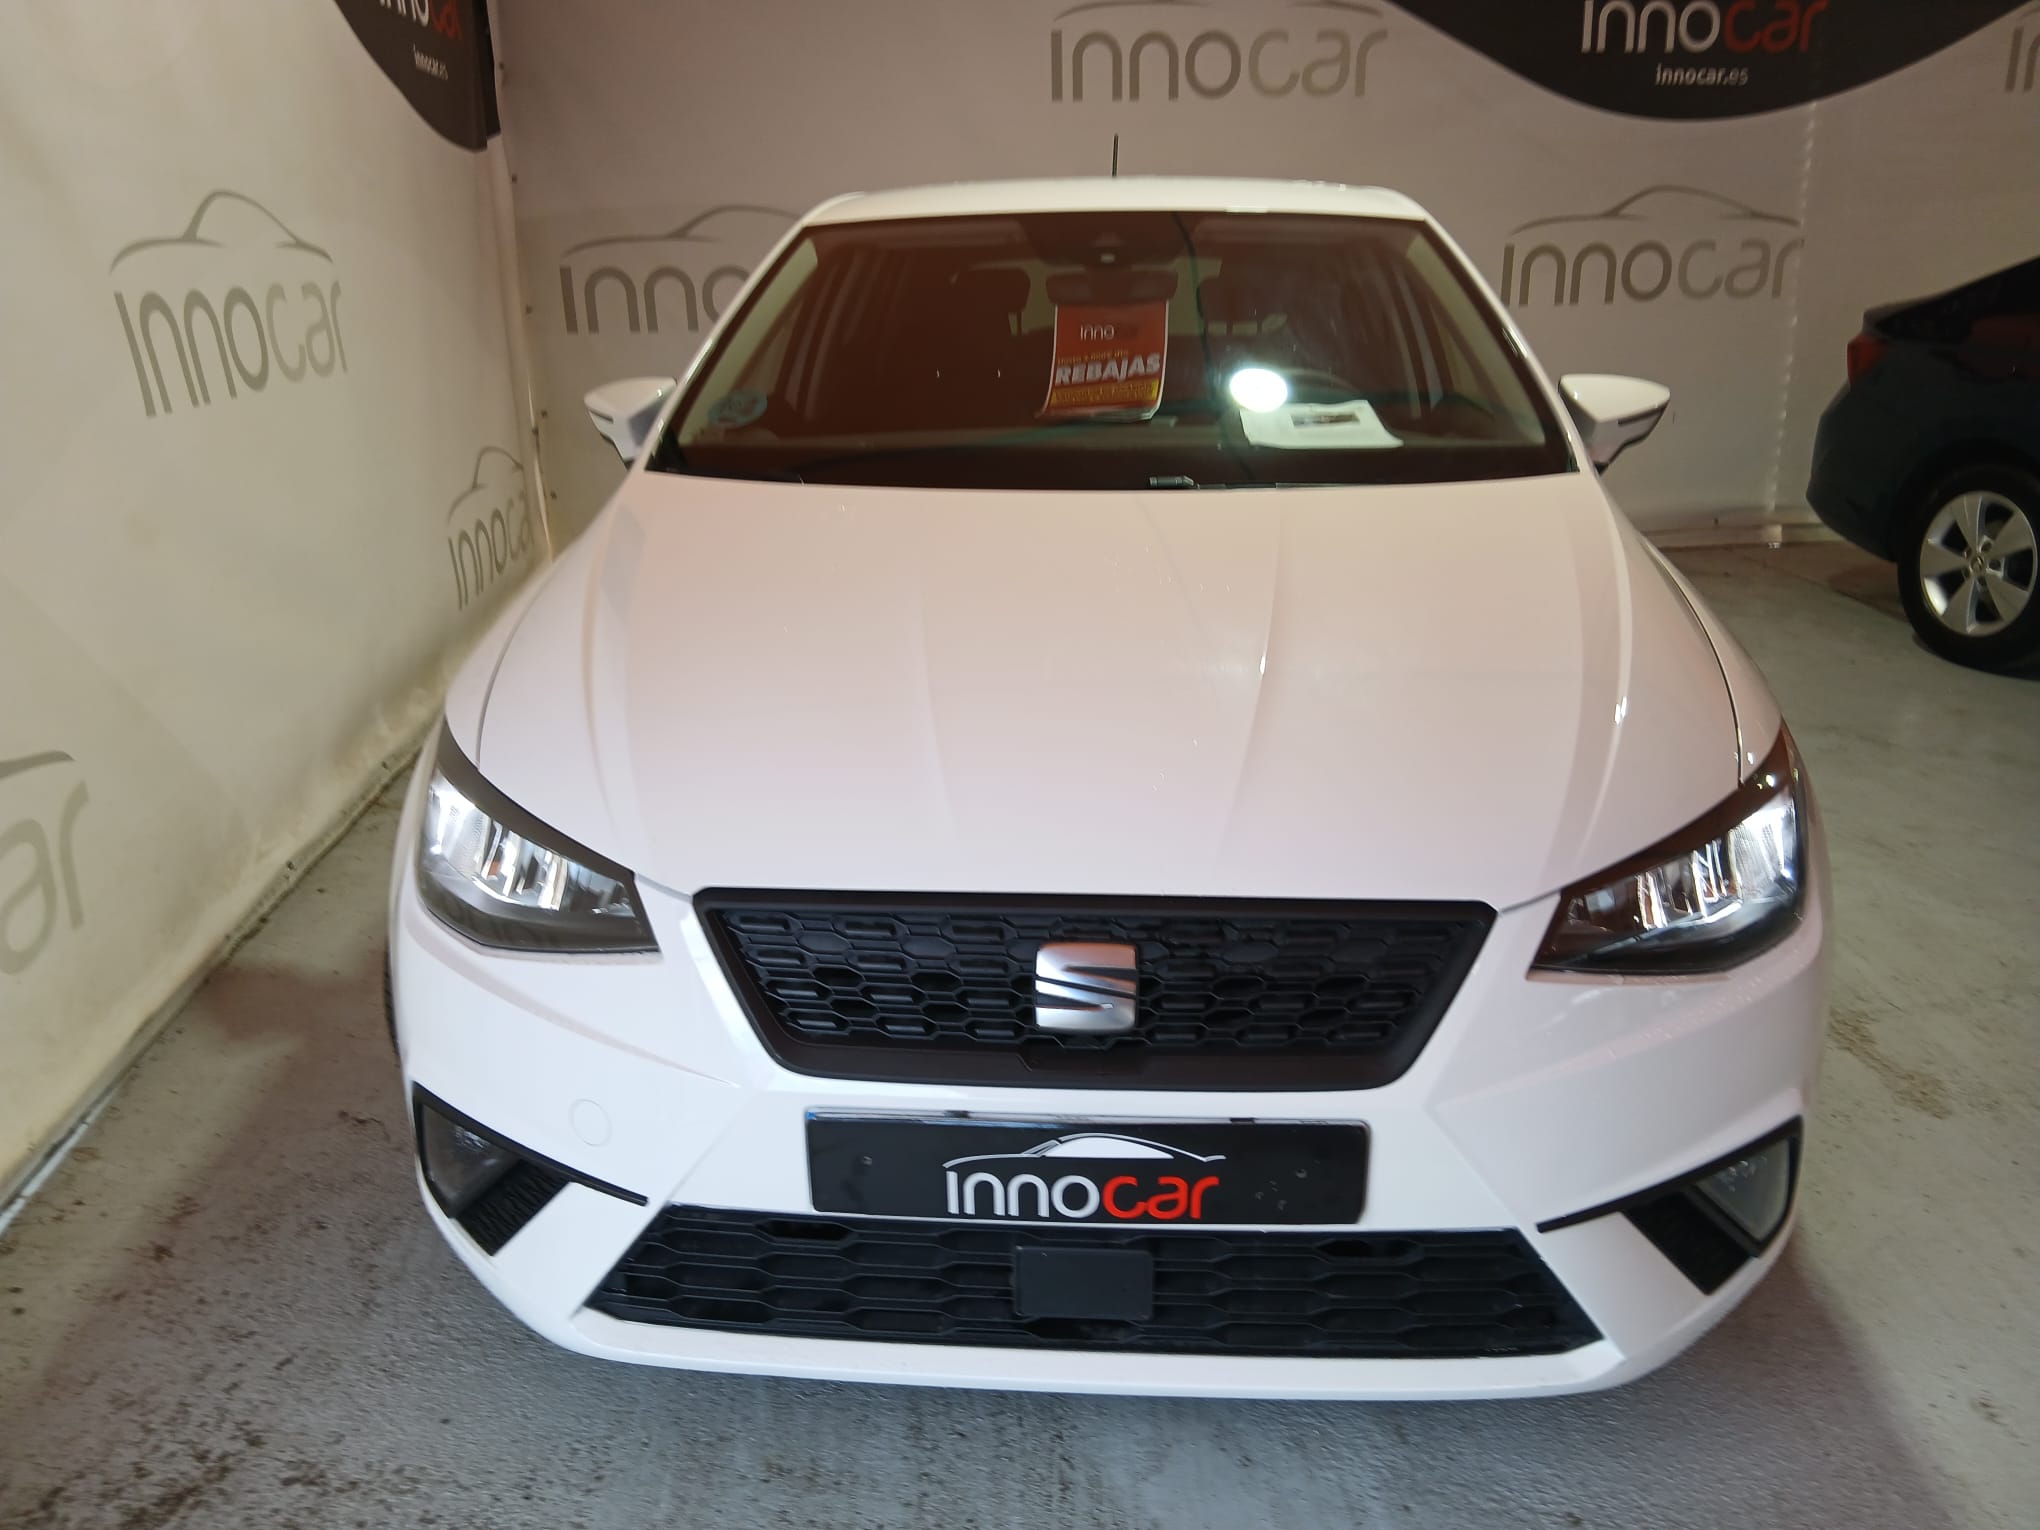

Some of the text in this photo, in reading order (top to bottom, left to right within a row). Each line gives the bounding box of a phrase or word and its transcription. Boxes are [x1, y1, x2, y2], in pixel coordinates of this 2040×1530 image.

[1581, 0, 1829, 54] innocar
[1050, 29, 1389, 102] innocar
[1655, 62, 1749, 86] innocar.es
[559, 264, 750, 334] inno
[1500, 238, 1805, 308] innocar
[113, 279, 348, 418] innocar
[1055, 353, 1161, 386] REBAJAS
[946, 1170, 1220, 1220] innocar
